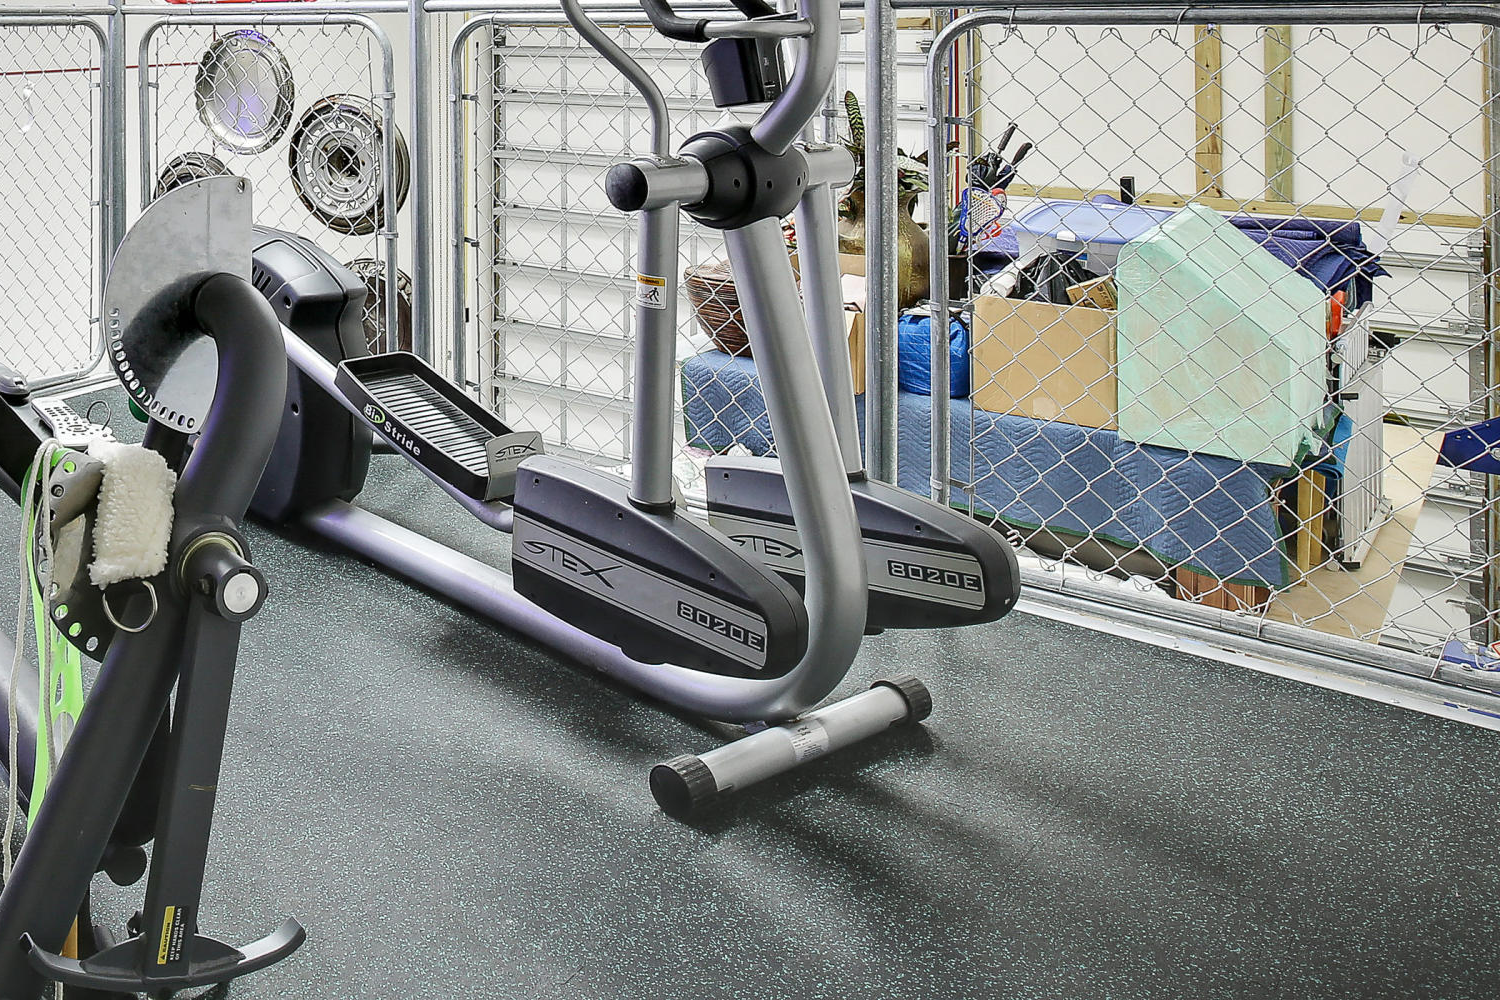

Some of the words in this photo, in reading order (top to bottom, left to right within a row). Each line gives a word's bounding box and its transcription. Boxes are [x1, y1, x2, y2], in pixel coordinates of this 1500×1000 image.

[384, 421, 421, 456] Stride
[495, 436, 538, 458] STEX
[522, 538, 624, 590] STEX
[890, 562, 980, 591] 8020E
[680, 604, 762, 651] 8020E
[163, 922, 171, 952] CAUTION
